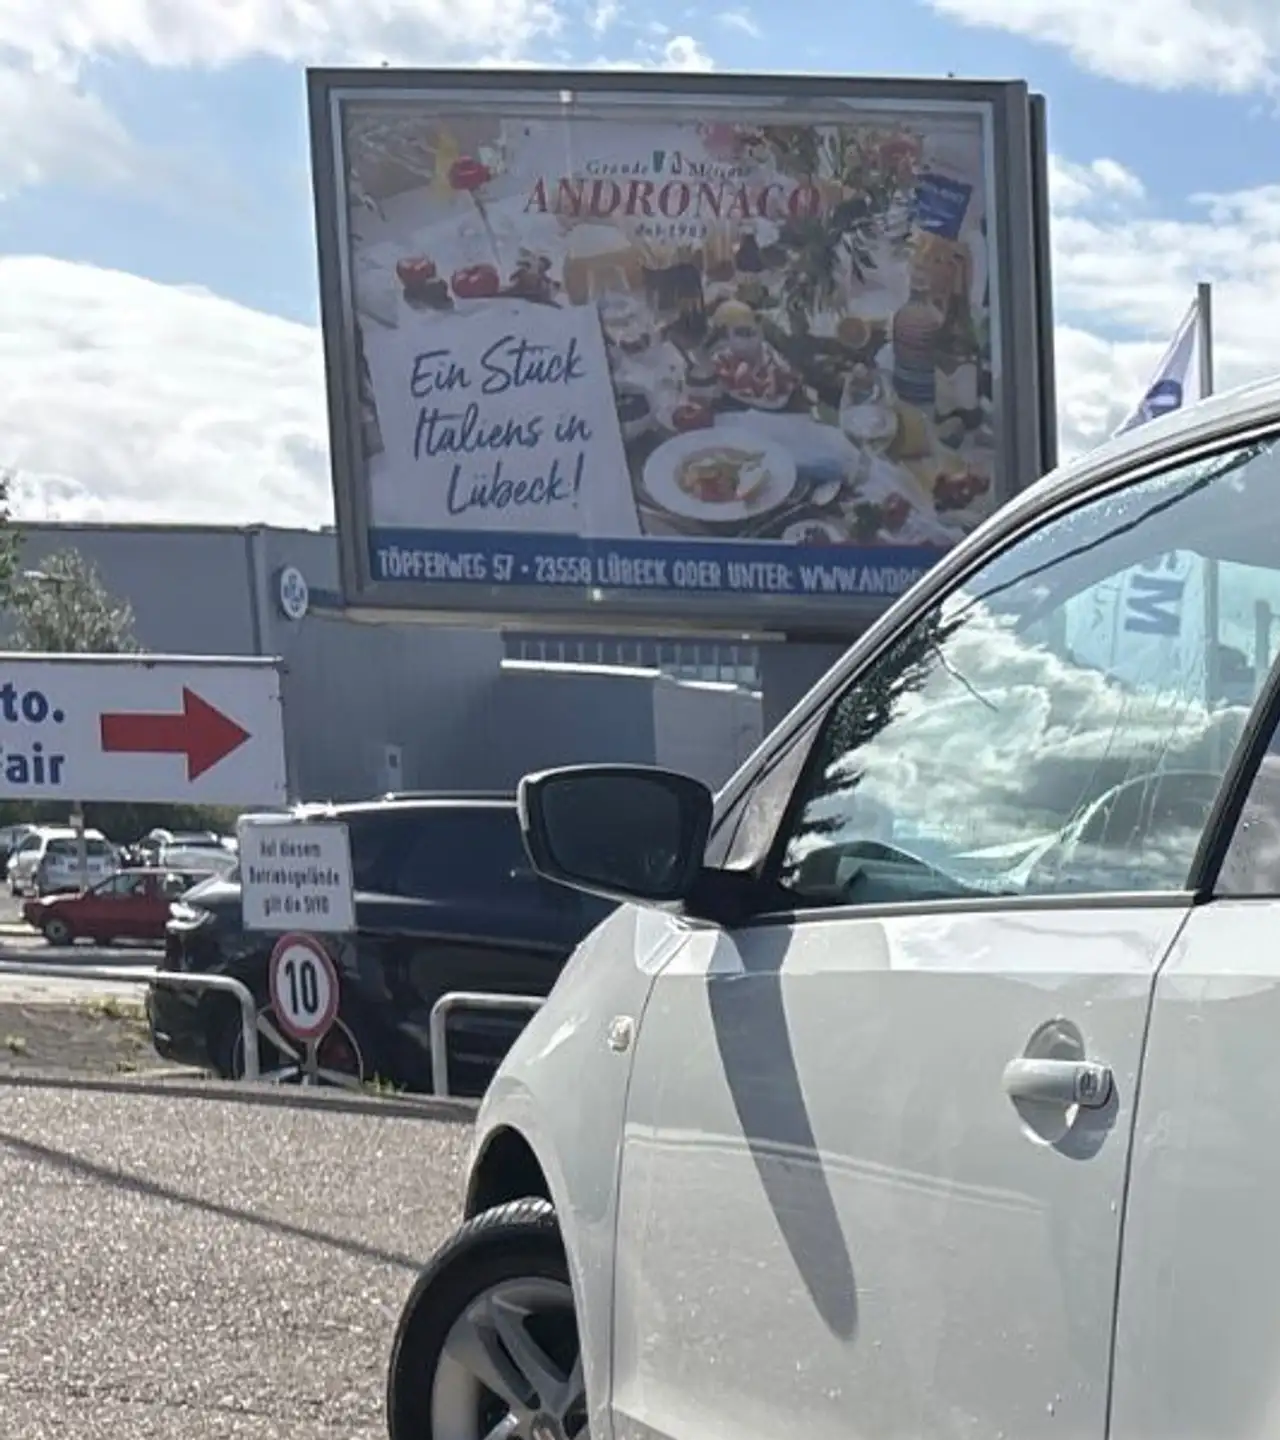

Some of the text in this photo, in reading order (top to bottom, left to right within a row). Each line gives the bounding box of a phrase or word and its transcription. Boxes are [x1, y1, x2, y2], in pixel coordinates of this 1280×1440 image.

[523, 175, 822, 219] ANDRONACO
[410, 335, 587, 398] Ein Stück
[414, 401, 593, 461] Italiens in
[446, 452, 584, 515] Lübeck!
[377, 546, 486, 580] TÖPFERWEG
[492, 553, 514, 581] 57
[535, 555, 593, 584] 23558
[597, 551, 666, 587] LÜBECK
[672, 560, 721, 588] ODER
[284, 958, 318, 1017] 10
